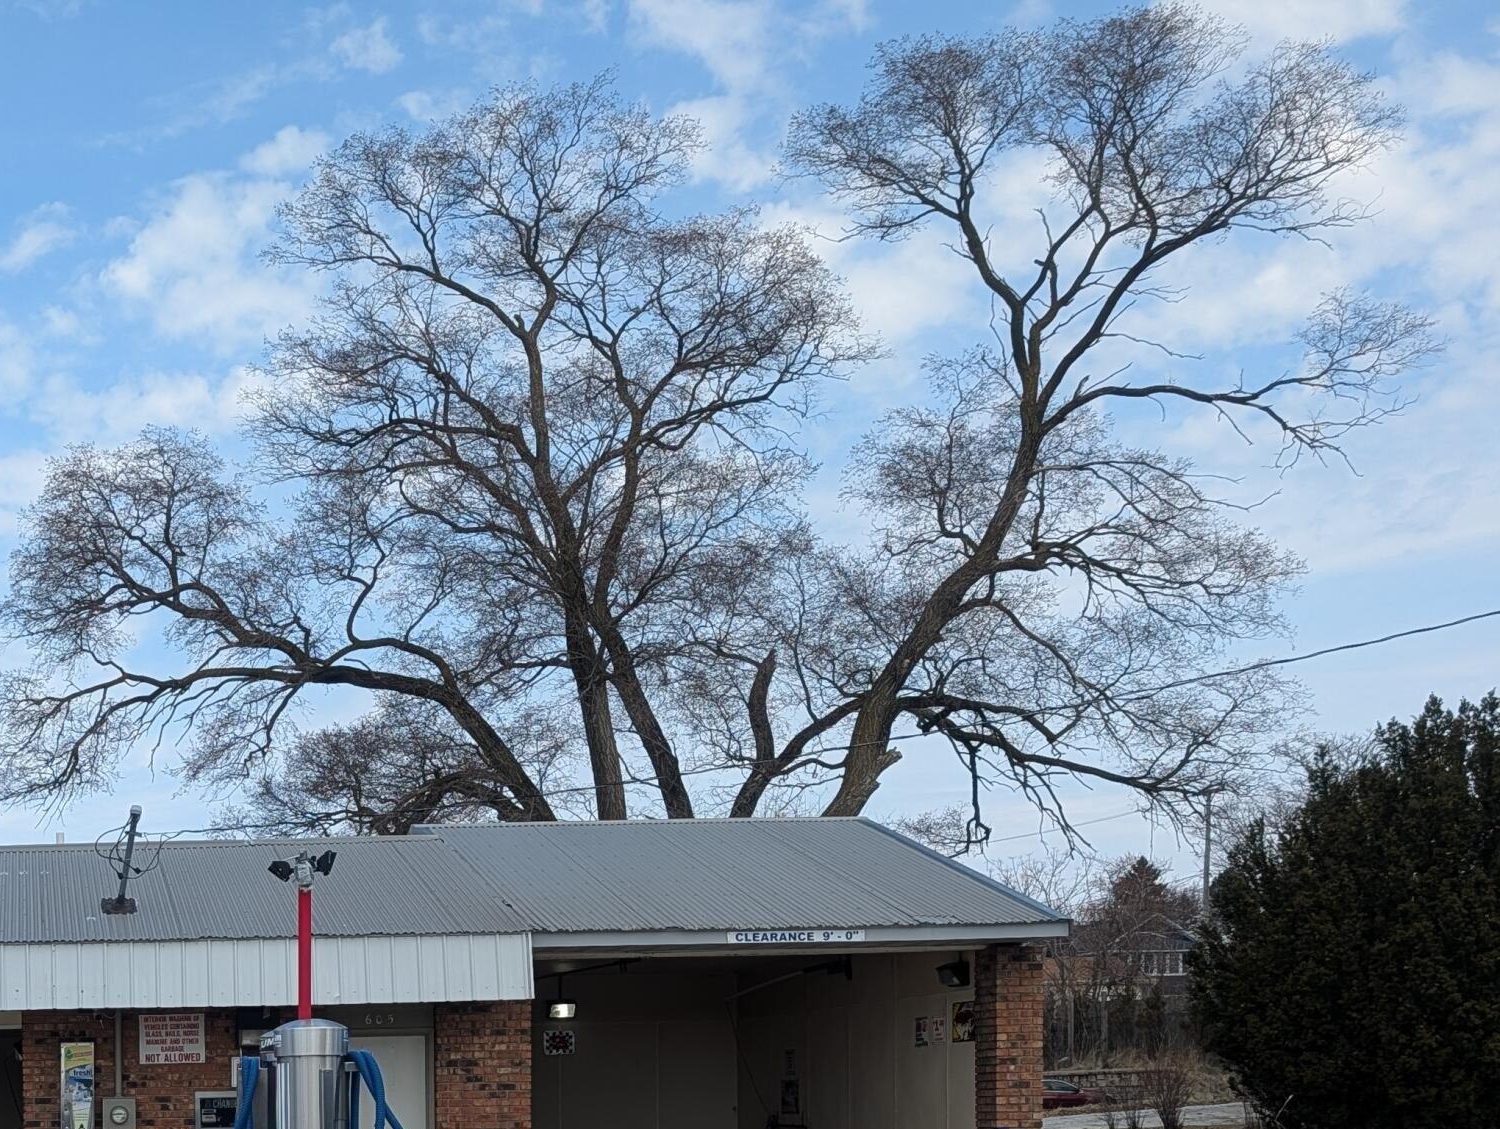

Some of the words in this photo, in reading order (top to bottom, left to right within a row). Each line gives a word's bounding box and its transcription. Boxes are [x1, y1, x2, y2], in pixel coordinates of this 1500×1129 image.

[735, 931, 815, 942] CLEARANCE
[365, 1014, 394, 1025] 605
[144, 1023, 168, 1031] VEHICLES
[145, 1053, 161, 1063] NOT
[163, 1052, 201, 1063] ALLOWED
